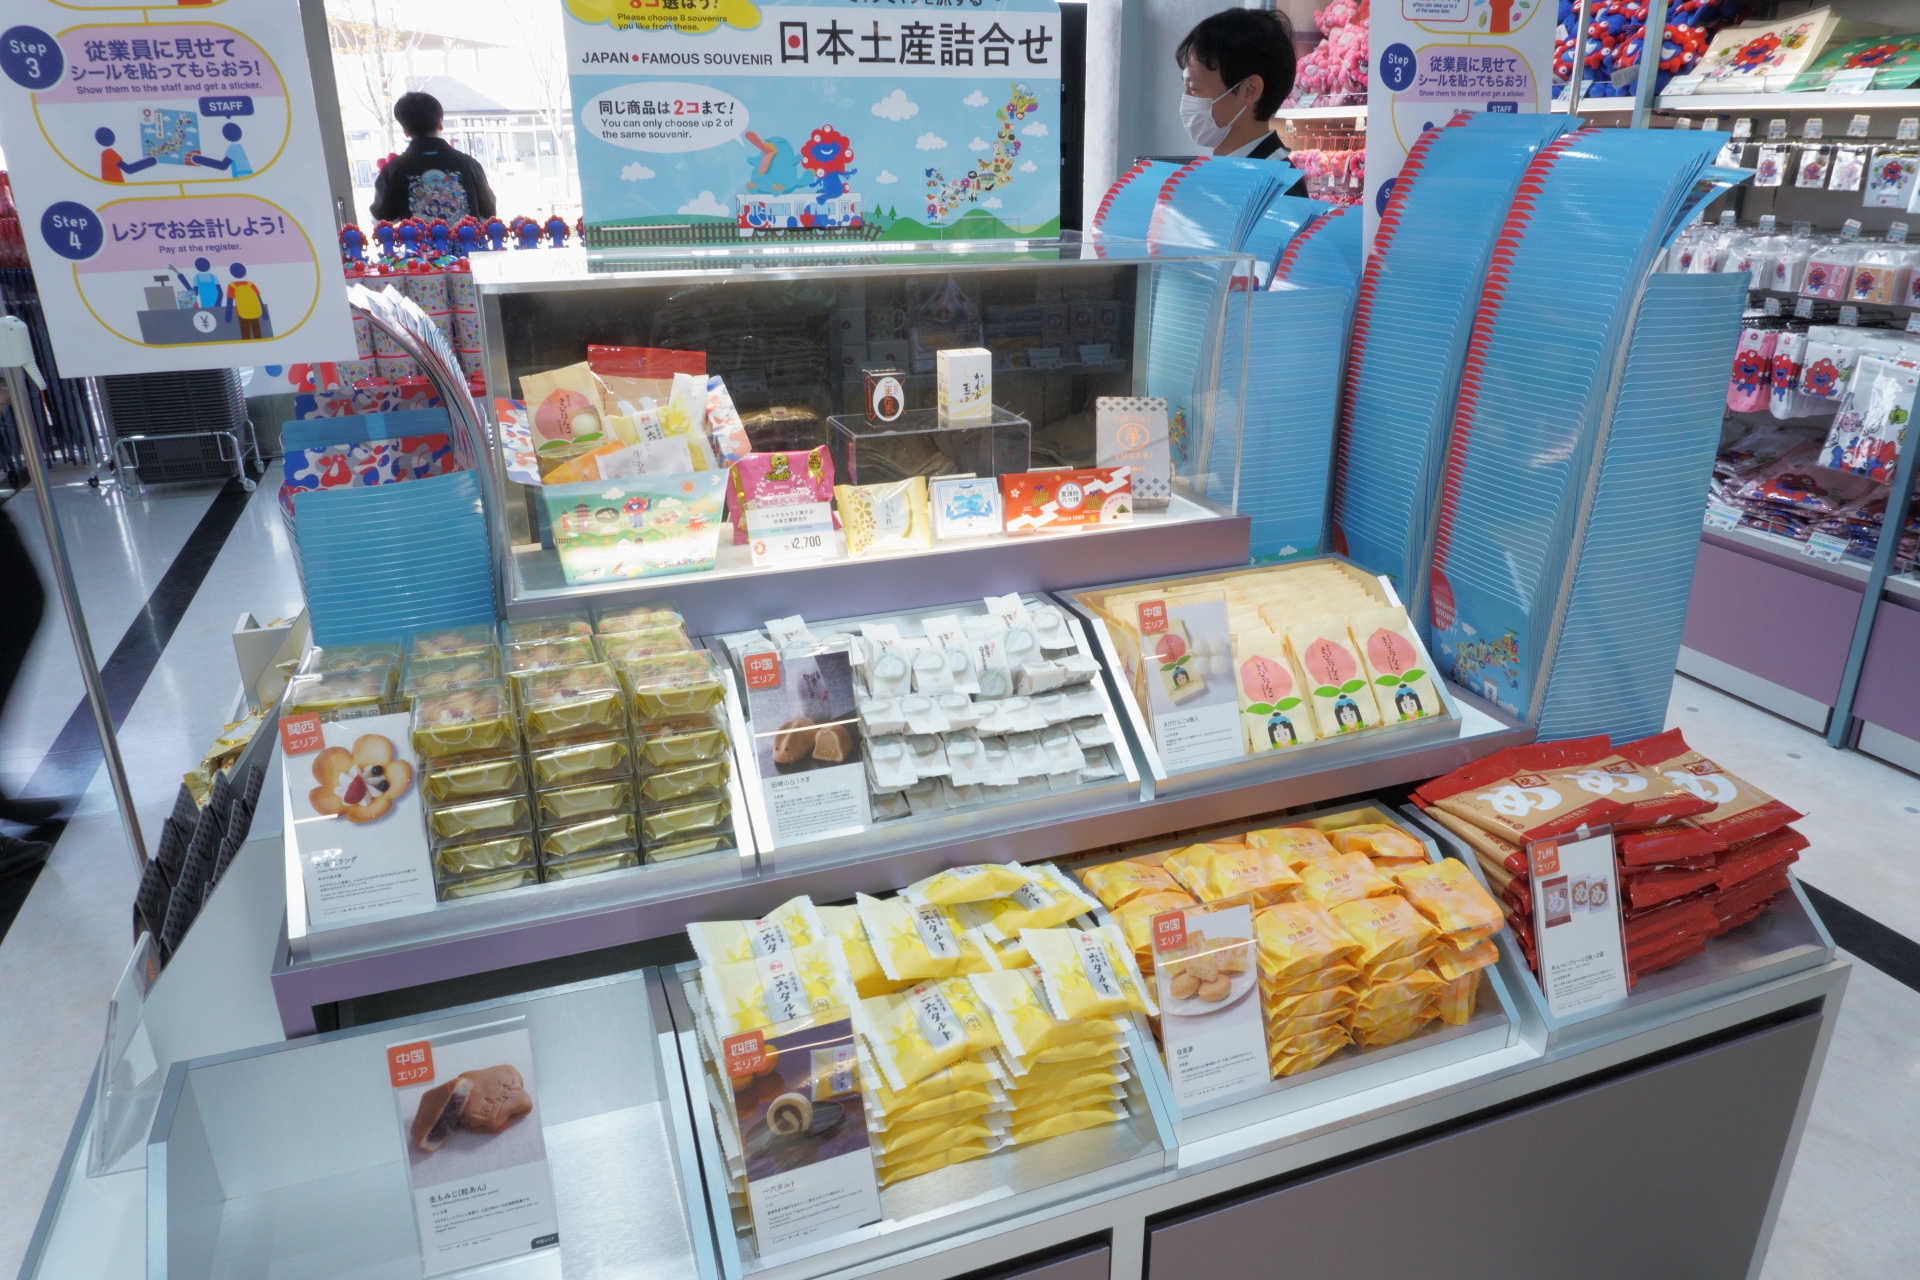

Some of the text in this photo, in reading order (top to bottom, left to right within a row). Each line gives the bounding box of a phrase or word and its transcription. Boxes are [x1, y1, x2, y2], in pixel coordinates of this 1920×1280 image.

[618, 13, 645, 21] Please
[688, 14, 727, 22] souvenirs
[636, 22, 650, 30] like
[652, 22, 672, 30] from
[674, 22, 699, 30] these.
[10, 39, 47, 57] Step
[84, 38, 235, 62] 従業員に見せて
[779, 19, 1053, 66] 日本土産詰合せ
[582, 52, 773, 65] JAPAN FAMOUS SOUVENIR
[1388, 53, 1409, 66] Step
[1430, 56, 1517, 73] 従業員に見せて
[26, 57, 41, 78] 3
[71, 60, 261, 81] シールを貼ってもらおう!
[1394, 67, 1402, 83] 3
[77, 86, 103, 94] Show
[106, 85, 129, 93] them
[131, 85, 141, 93] to
[143, 84, 159, 92] the
[160, 83, 182, 91] staff
[184, 82, 201, 91] and
[204, 83, 219, 93] get
[229, 81, 262, 90] sticker.
[1418, 74, 1527, 87] シールを貼ってもらおう!
[208, 101, 243, 111] STAFF
[1492, 105, 1513, 113] STAFF
[601, 119, 621, 127] You
[642, 119, 662, 129] only
[664, 119, 699, 127] choose
[701, 120, 713, 129] up
[716, 119, 722, 127] 2
[724, 119, 733, 127] of
[602, 130, 618, 138] the
[648, 130, 692, 138] souvenir.
[53, 214, 88, 229] Step
[112, 216, 285, 242] レジでお会計しよう!
[69, 231, 81, 249] 4
[159, 243, 242, 254] Pay at the register.
[791, 535, 821, 550] ¥2,700
[1144, 606, 1163, 618] 中国
[1436, 607, 1458, 625] FAMOUS
[1145, 619, 1164, 629] エリア
[1436, 617, 1458, 636] JAPAN
[751, 658, 773, 671] 中国
[751, 673, 776, 684] エリア
[287, 720, 315, 736] 関西
[290, 736, 318, 750] エリア
[1476, 785, 1562, 817] め
[1548, 807, 1590, 827] MENBEI
[1727, 808, 1766, 824] MENBEI
[1642, 825, 1684, 836] MENBEI
[1537, 846, 1555, 860] 九州
[1232, 865, 1260, 876] 母恵夢
[1538, 861, 1556, 872] エリア
[1324, 873, 1351, 887] 母恵夢
[1548, 891, 1565, 913] め
[1159, 918, 1180, 933] 四国
[1371, 912, 1397, 926] 母恵夢
[919, 909, 945, 951] 一六タルト
[1288, 926, 1314, 941] 母恵夢
[1160, 934, 1183, 946] エリア
[1085, 947, 1110, 993] 一六タルト
[773, 973, 796, 1020] 一六タルト
[920, 996, 950, 1041] 一六タルト
[731, 1039, 758, 1056] 四国
[396, 1049, 424, 1066] 中国
[733, 1056, 761, 1071] エリア
[397, 1067, 428, 1081] エリア
[763, 1180, 795, 1193] 一六タルト
